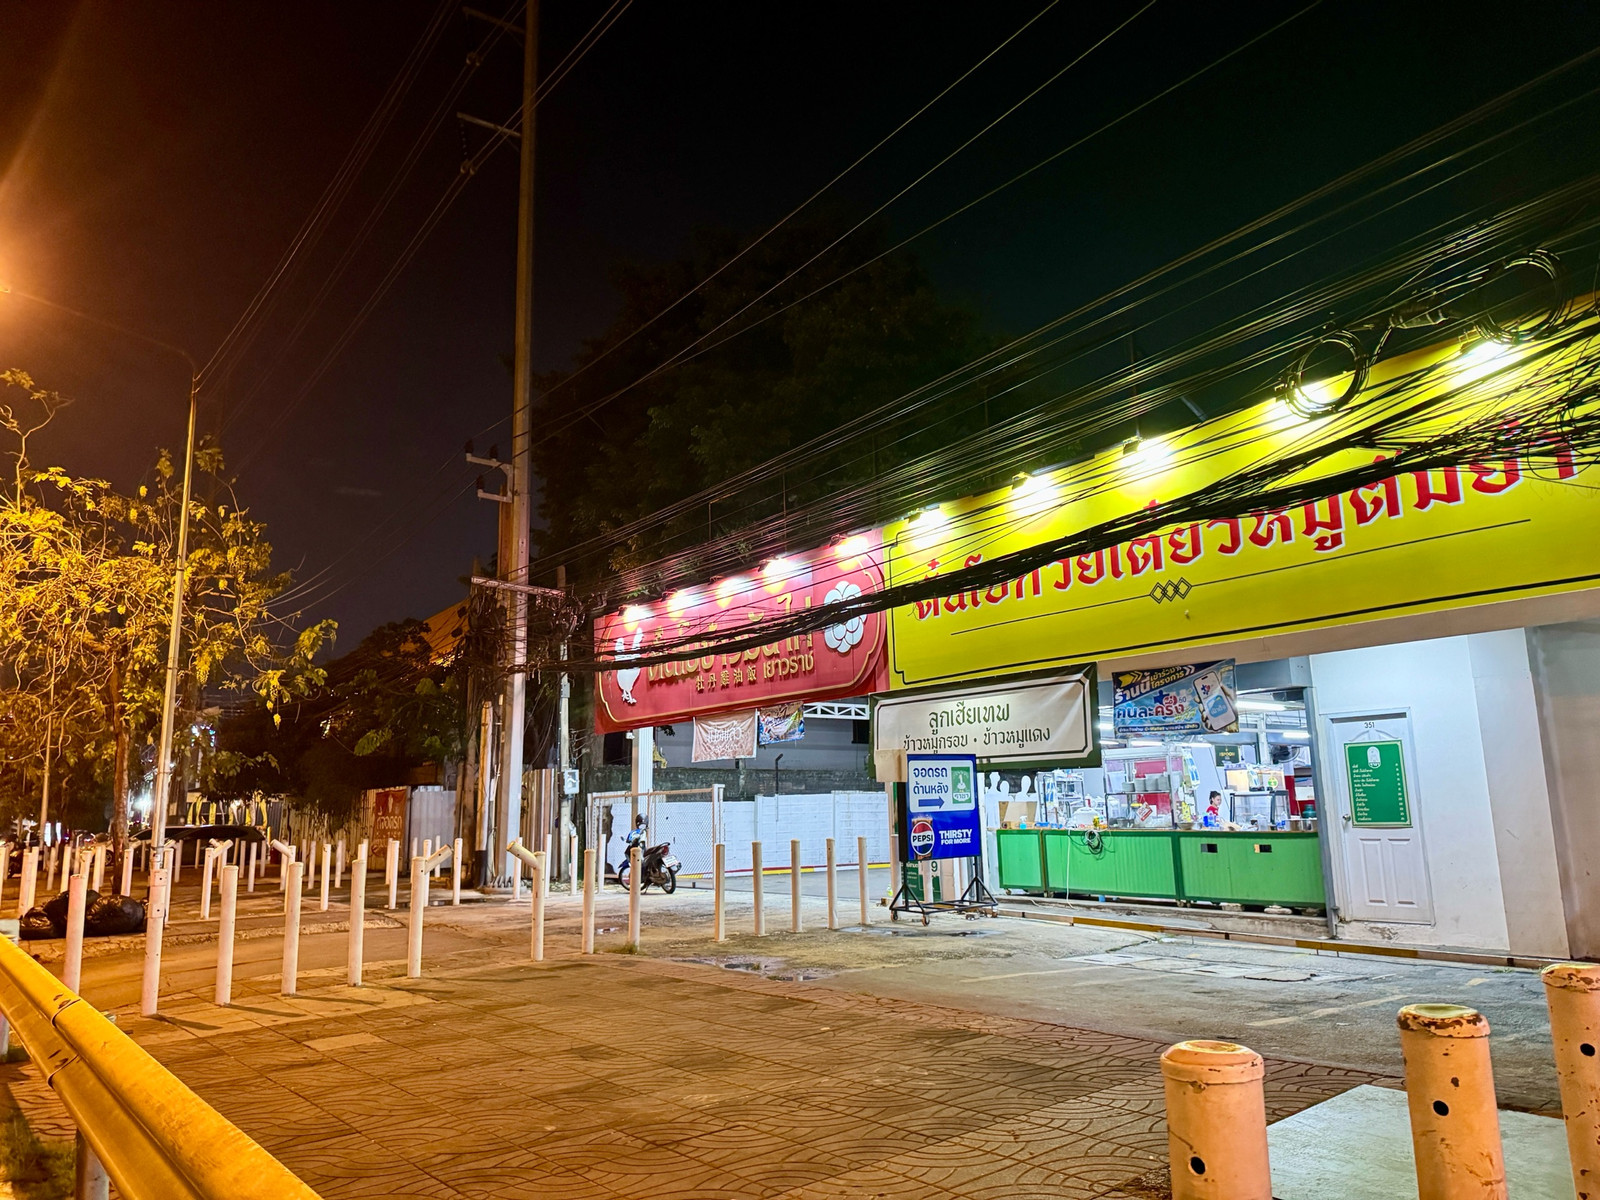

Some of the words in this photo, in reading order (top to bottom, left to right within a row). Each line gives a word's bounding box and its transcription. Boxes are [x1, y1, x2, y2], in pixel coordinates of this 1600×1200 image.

[763, 651, 814, 679] เยาวราช
[1114, 671, 1151, 704] ร้านนี้
[1150, 670, 1185, 689] โครงการ
[929, 700, 1010, 735] ลูกเฮียเทพ
[903, 733, 968, 754] ข้าวหมูกรอบ
[983, 727, 1051, 748] ข้าวหมูแดง
[913, 767, 948, 778] จอดรถ
[913, 781, 949, 795] ด้านหลัง
[912, 834, 934, 843] PEPSI
[939, 829, 972, 839] THIRSTY
